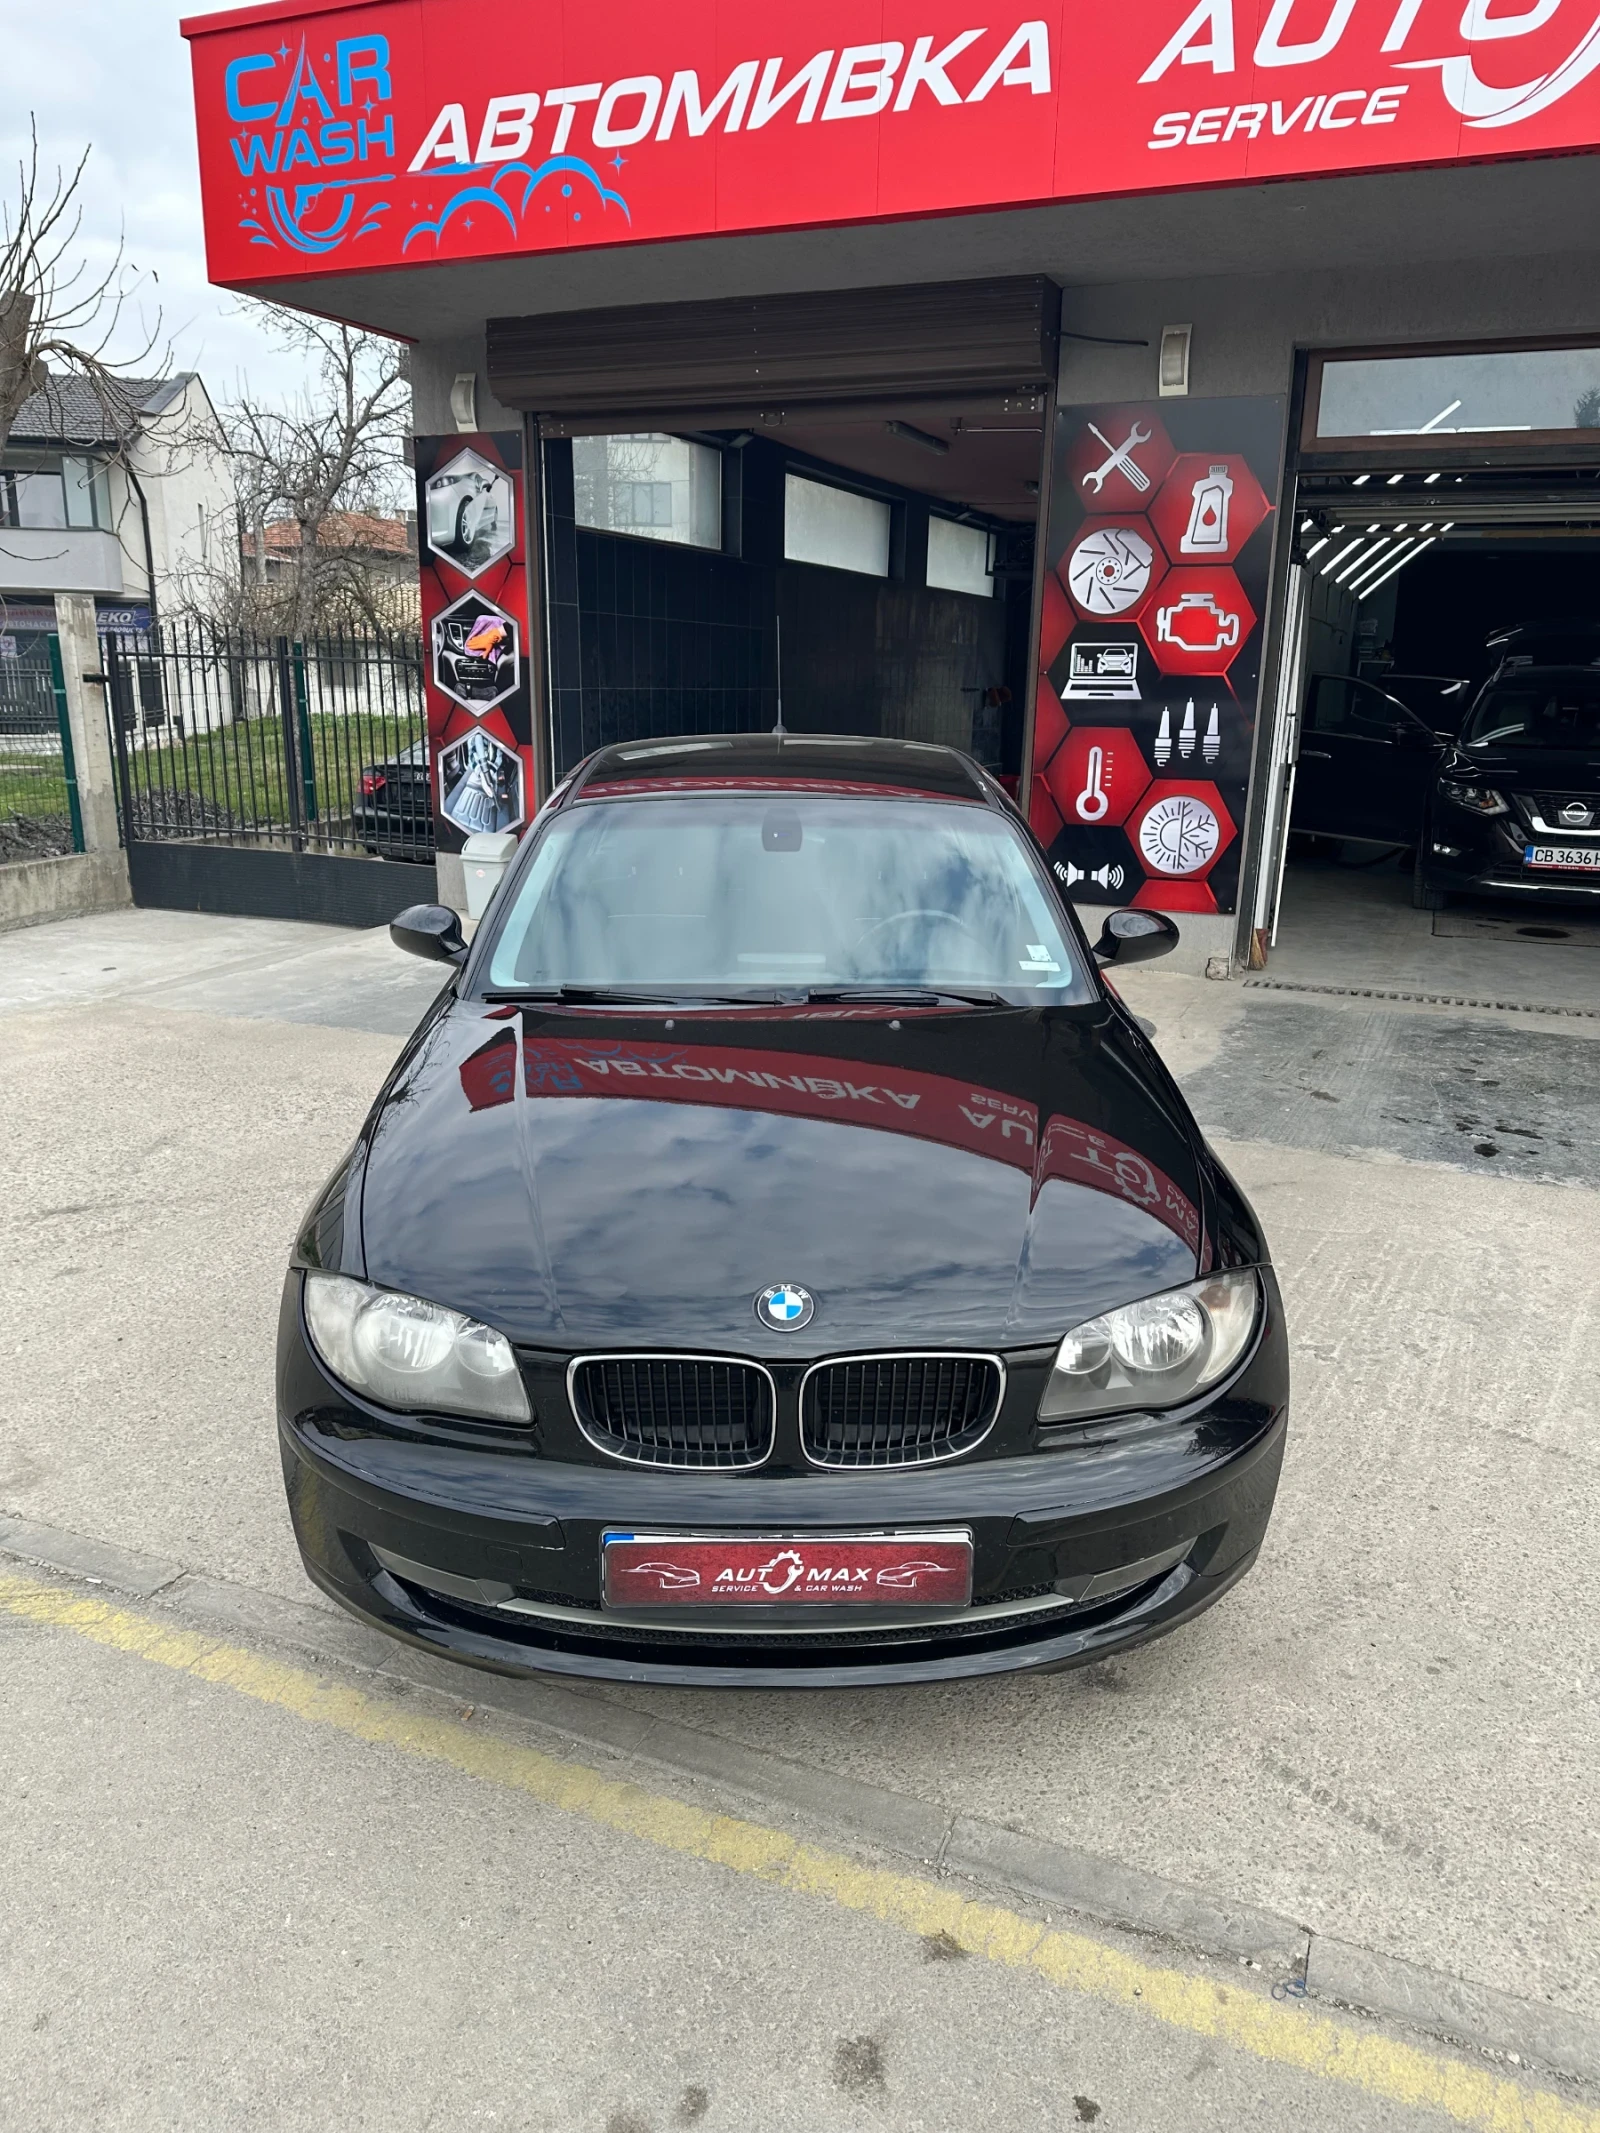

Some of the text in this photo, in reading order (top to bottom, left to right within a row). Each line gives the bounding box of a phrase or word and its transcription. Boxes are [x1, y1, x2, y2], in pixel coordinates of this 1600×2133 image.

[225, 31, 392, 127] CAR
[406, 20, 1052, 173] АВТОМИВКА
[229, 114, 395, 177] WASH
[1147, 84, 1410, 150] SERVICE
[1535, 849, 1554, 863] CB
[1556, 850, 1592, 865] 3636
[764, 1285, 809, 1299] BMW
